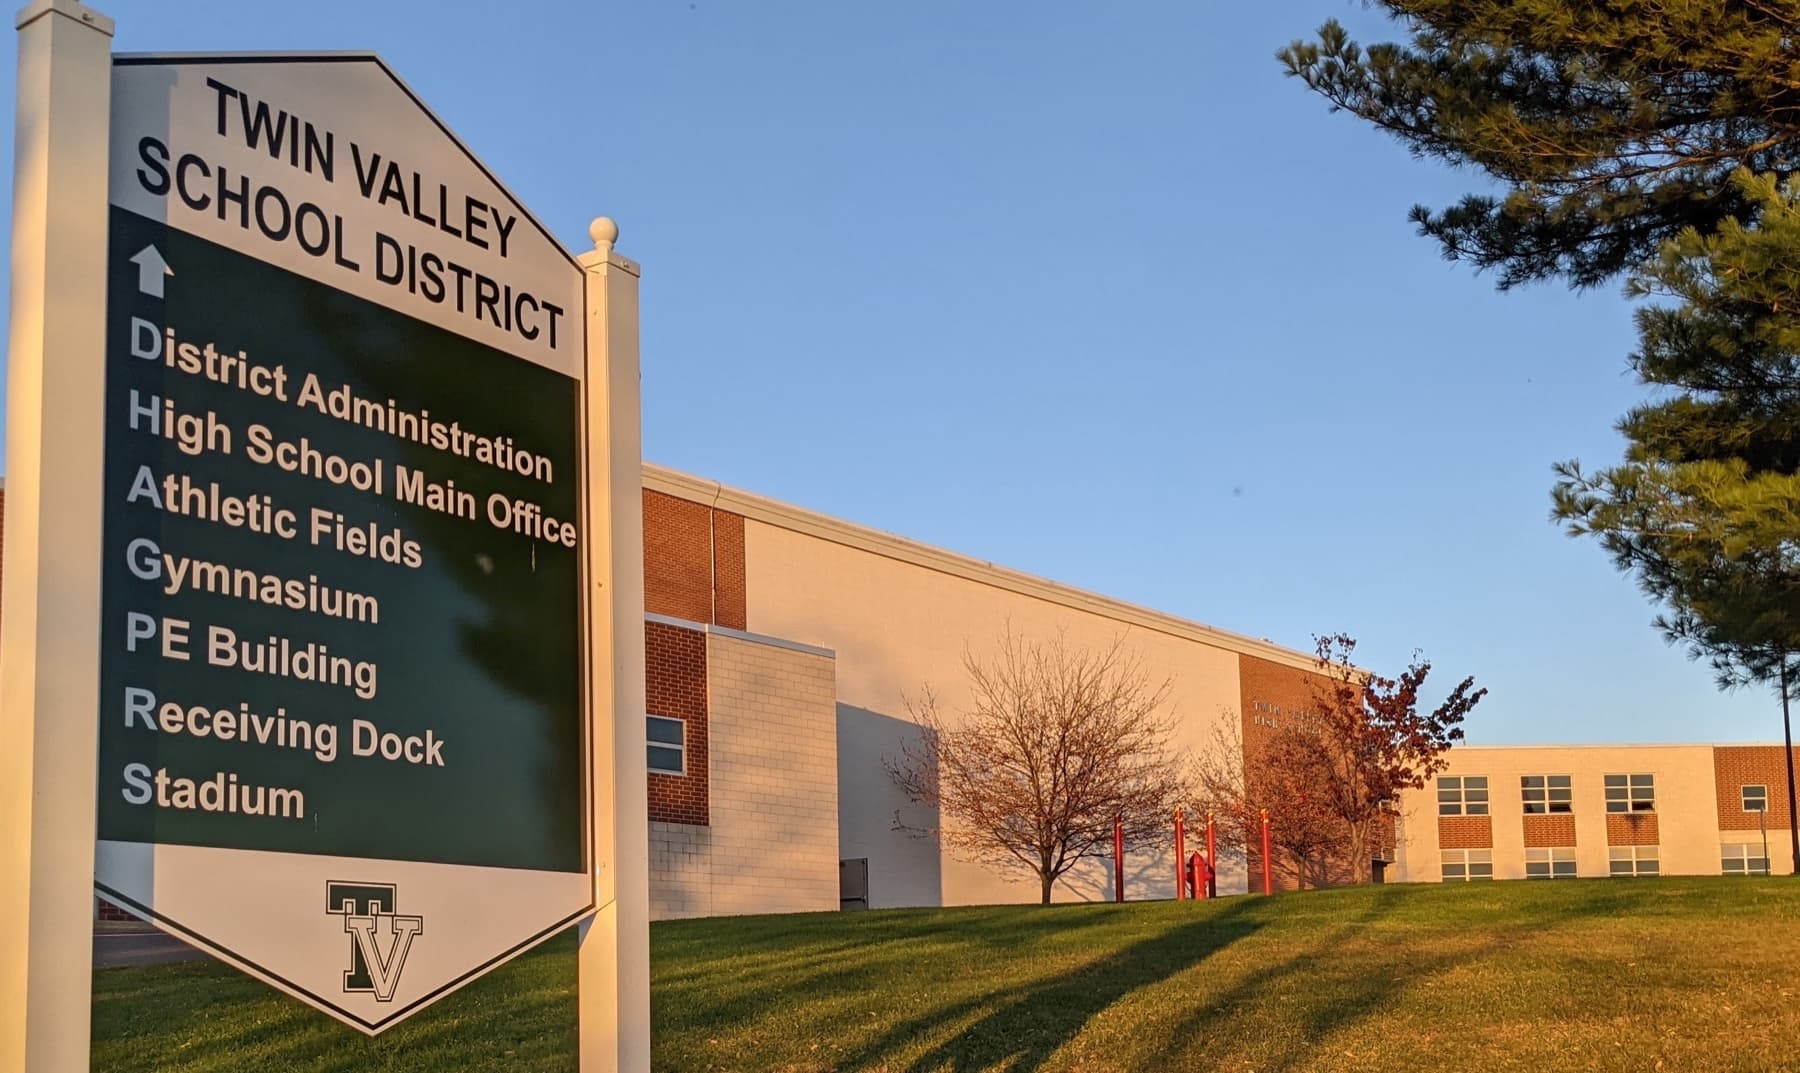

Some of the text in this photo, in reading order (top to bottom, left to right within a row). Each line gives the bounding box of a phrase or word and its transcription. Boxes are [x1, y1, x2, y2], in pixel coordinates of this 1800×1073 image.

[206, 77, 517, 258] TWIN VALLEY
[136, 136, 564, 349] SCHOOL DISTRICT
[130, 316, 552, 483] District Administration
[127, 465, 423, 569] Athletic Fields
[129, 389, 577, 549] High School Main Office
[126, 538, 379, 625] Gymnasium
[126, 611, 377, 699] PE Building
[124, 686, 445, 767] Receiving Dock
[121, 762, 304, 818] Stadium
